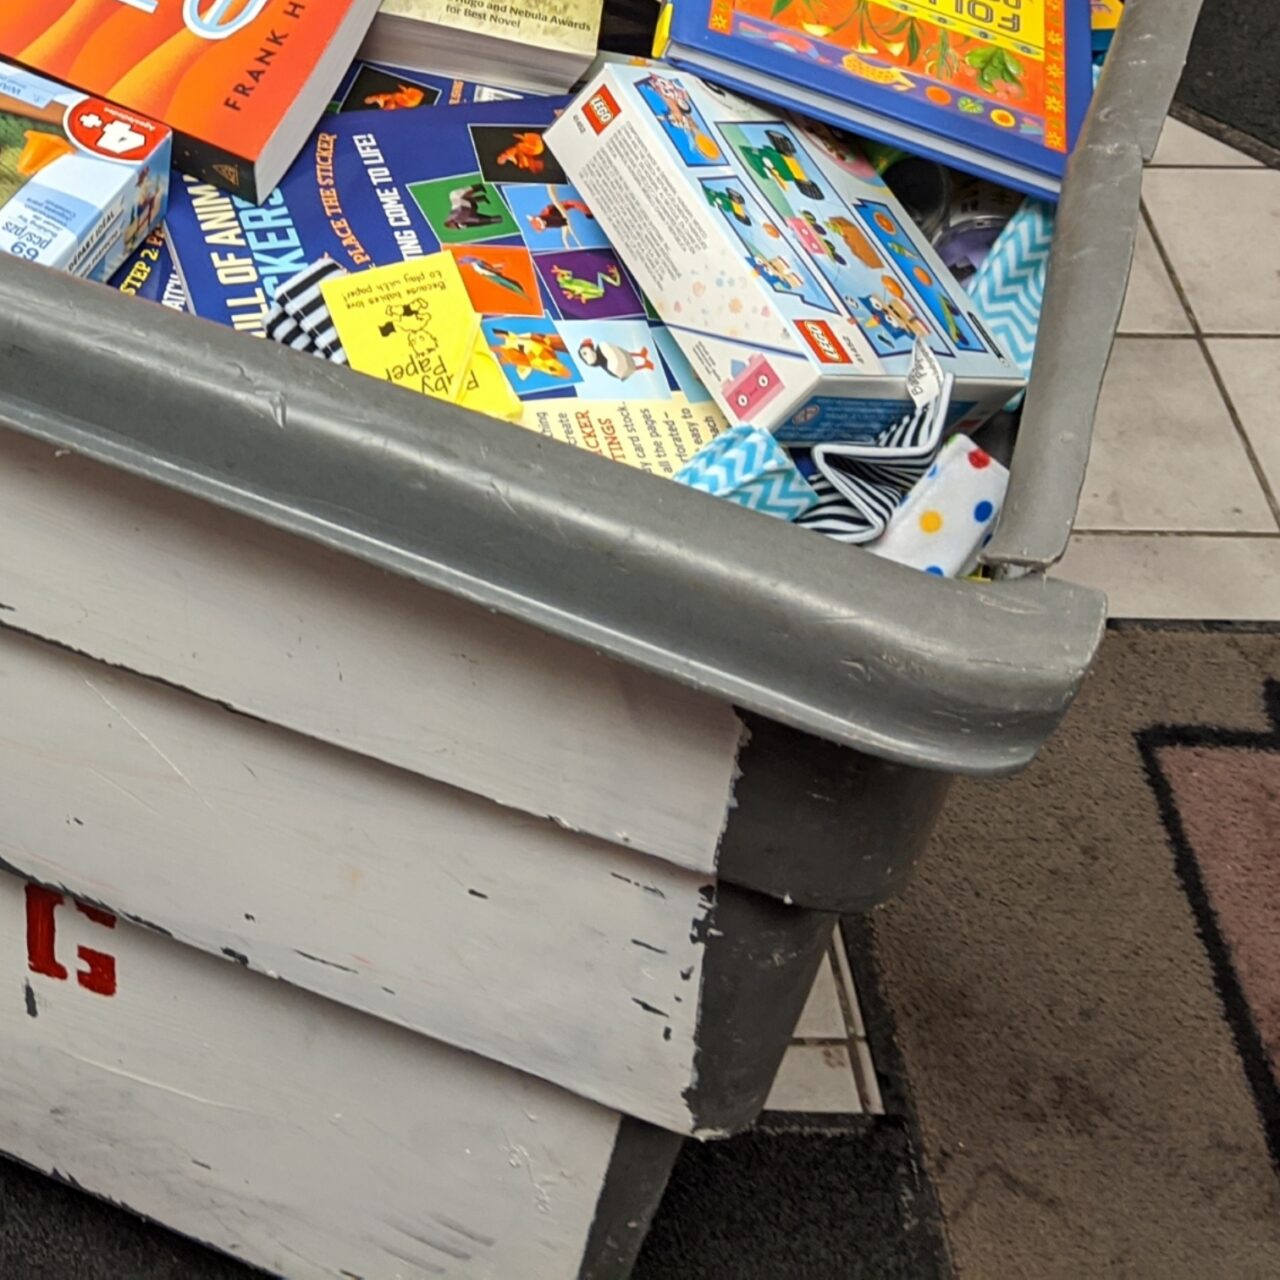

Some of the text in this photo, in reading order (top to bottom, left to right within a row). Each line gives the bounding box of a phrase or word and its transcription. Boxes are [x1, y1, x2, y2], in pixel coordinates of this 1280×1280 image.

[445, 3, 521, 28] for Best Novel
[486, 0, 508, 14] and
[509, 5, 548, 23] Nebula
[549, 14, 591, 32] Awards
[224, 28, 289, 112] FRANK
[589, 96, 614, 125] LEGO
[352, 132, 386, 169] LIFE!
[366, 166, 394, 188] TO
[315, 132, 370, 266] PLACE THE STICKER
[376, 187, 413, 228] COME
[2, 220, 53, 250] pcs/pzs
[10, 241, 40, 261] 69
[121, 261, 152, 295] STEP
[210, 252, 260, 285] OF
[343, 270, 442, 303] to play with paper!
[346, 280, 446, 310] Because babies love
[804, 320, 843, 363] LEGO
[385, 354, 448, 382] Paper
[617, 401, 646, 460] card stock.
[640, 407, 673, 474] all the pages
[681, 407, 704, 446] easy to
